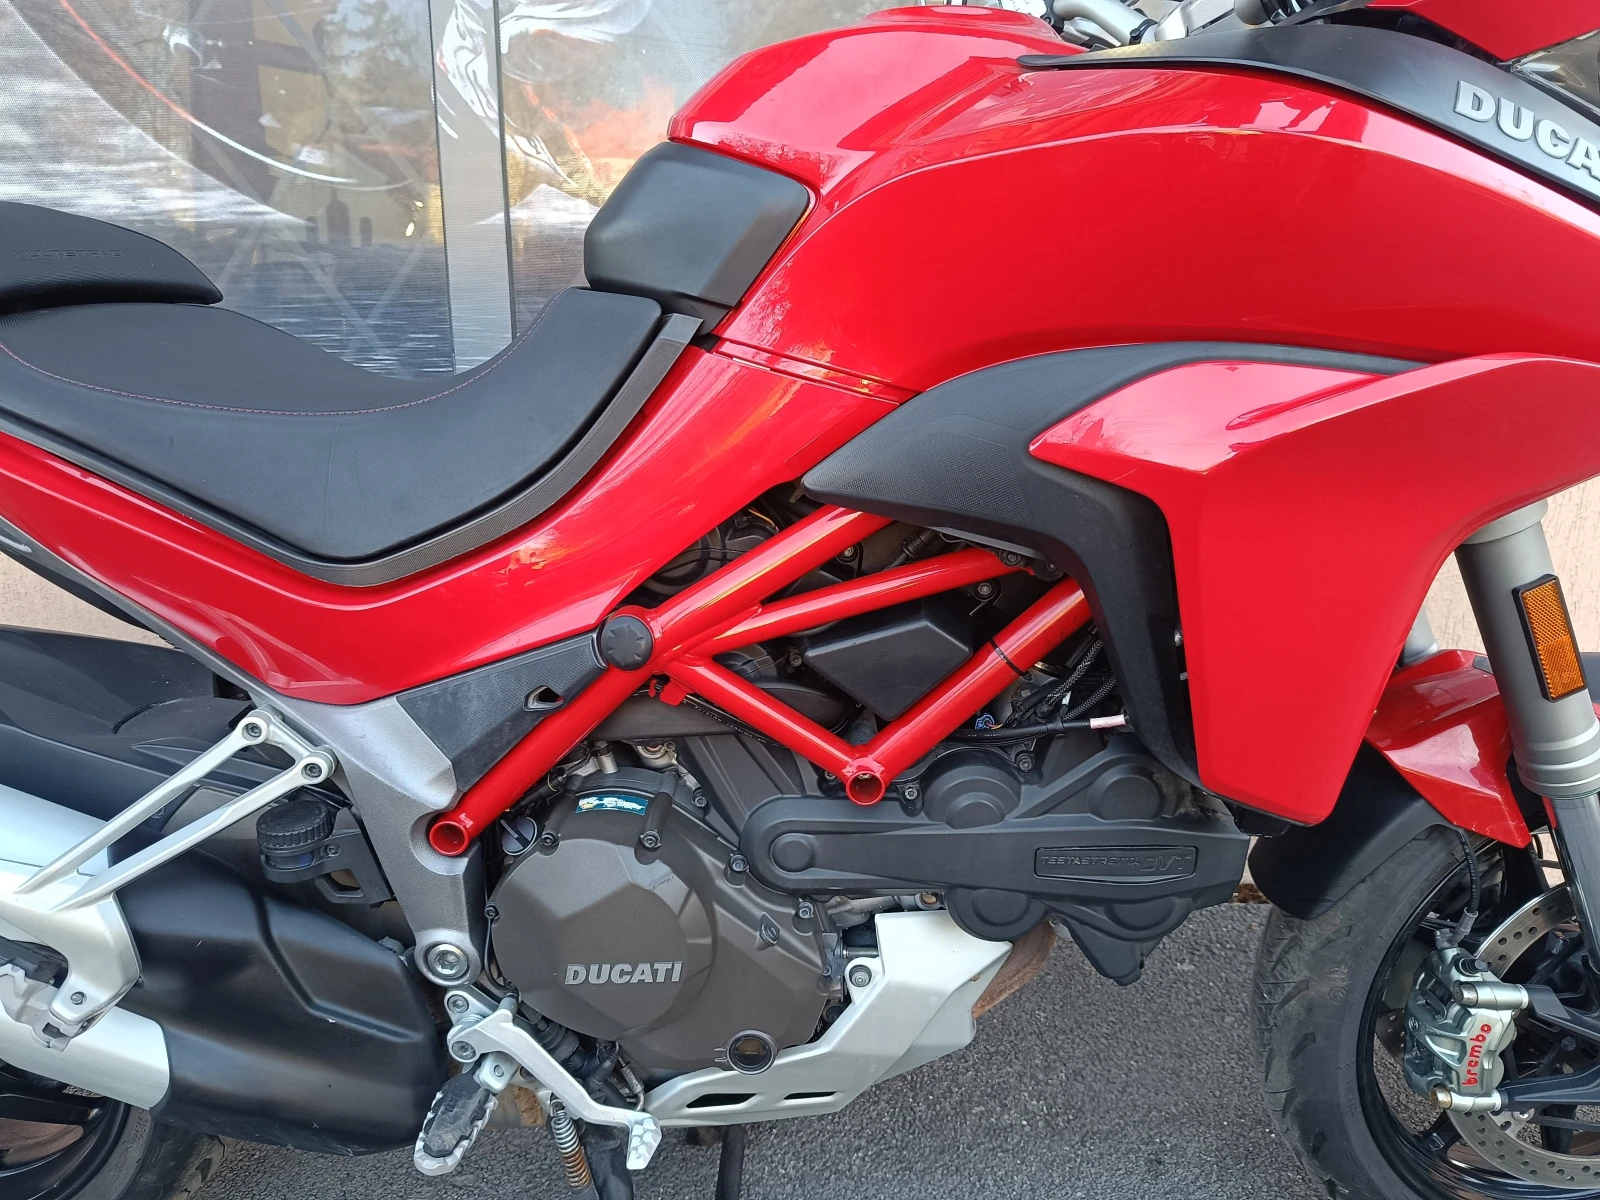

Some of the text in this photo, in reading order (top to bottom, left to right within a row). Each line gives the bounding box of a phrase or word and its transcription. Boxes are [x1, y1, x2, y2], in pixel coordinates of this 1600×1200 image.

[1040, 855, 1192, 872] TESTASTRETTA DVT
[564, 961, 683, 985] DUCATI
[1461, 1023, 1492, 1087] brembo
